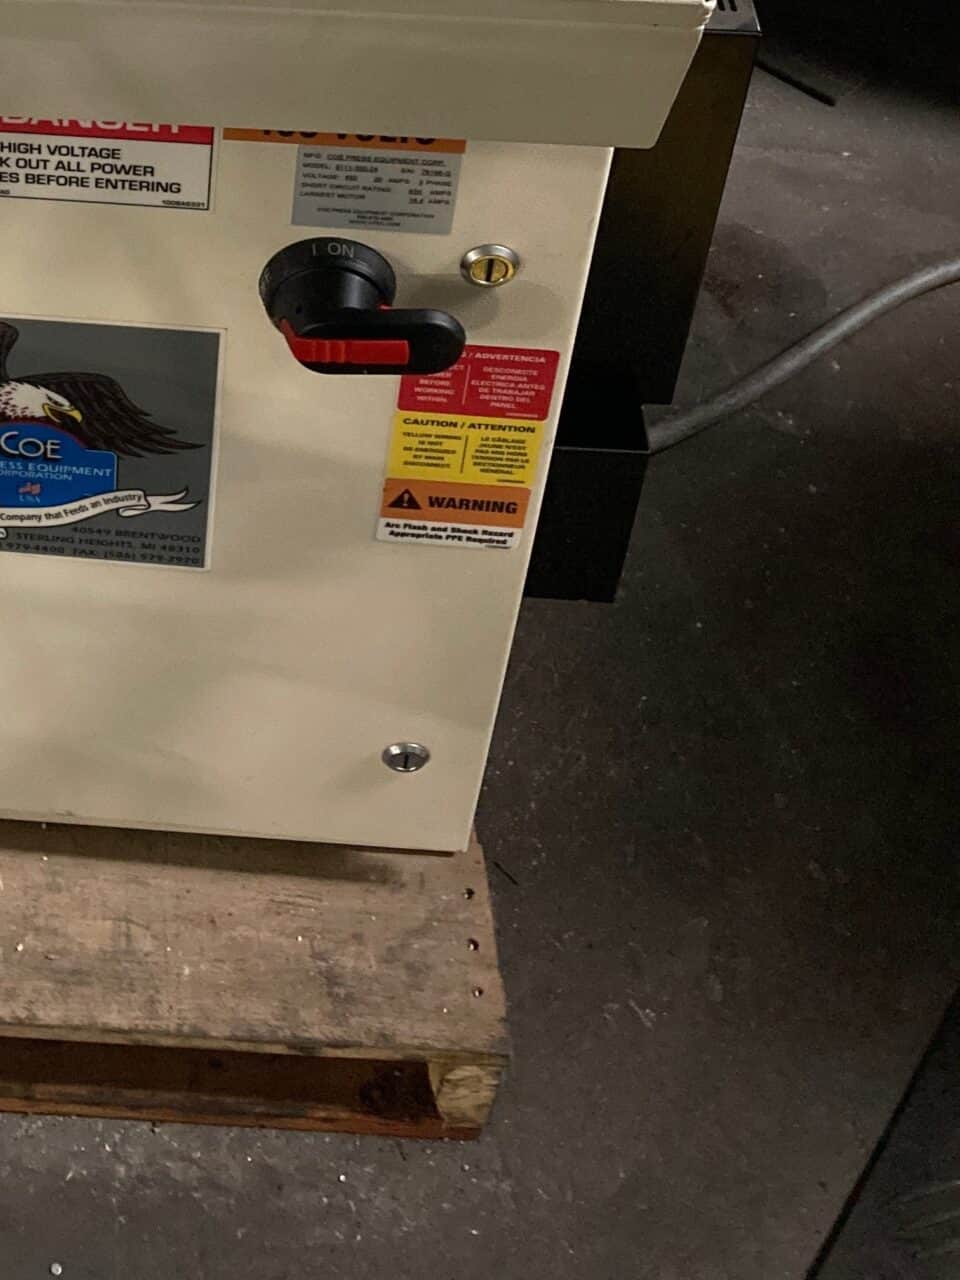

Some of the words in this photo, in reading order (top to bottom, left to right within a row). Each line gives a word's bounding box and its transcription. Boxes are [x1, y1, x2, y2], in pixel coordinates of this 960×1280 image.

[0, 141, 42, 155] HIGH
[46, 143, 121, 160] VOLTAGE
[15, 157, 48, 170] OUT
[54, 160, 85, 173] ALL
[90, 162, 155, 177] POWER
[25, 172, 90, 188] BEFORE
[95, 177, 182, 194] ENTERING
[327, 241, 355, 258] ON
[474, 352, 546, 363] ADVERTENCIA
[402, 417, 458, 428] CAUTION
[467, 421, 536, 434] ATTENTION
[0, 430, 63, 459] COE
[26, 462, 114, 477] EQUIPMENT
[0, 512, 42, 523] Company
[44, 510, 63, 520] that
[63, 505, 90, 517] Feeds
[90, 499, 103, 509] an
[103, 493, 142, 506] Industry
[428, 495, 518, 514] WARNING
[384, 521, 401, 529] Arc
[403, 523, 428, 531] Flash
[431, 525, 448, 533] and
[450, 527, 478, 535] Shock
[389, 530, 443, 540] Appropriate
[445, 533, 463, 541] PPE
[465, 535, 507, 545] Required
